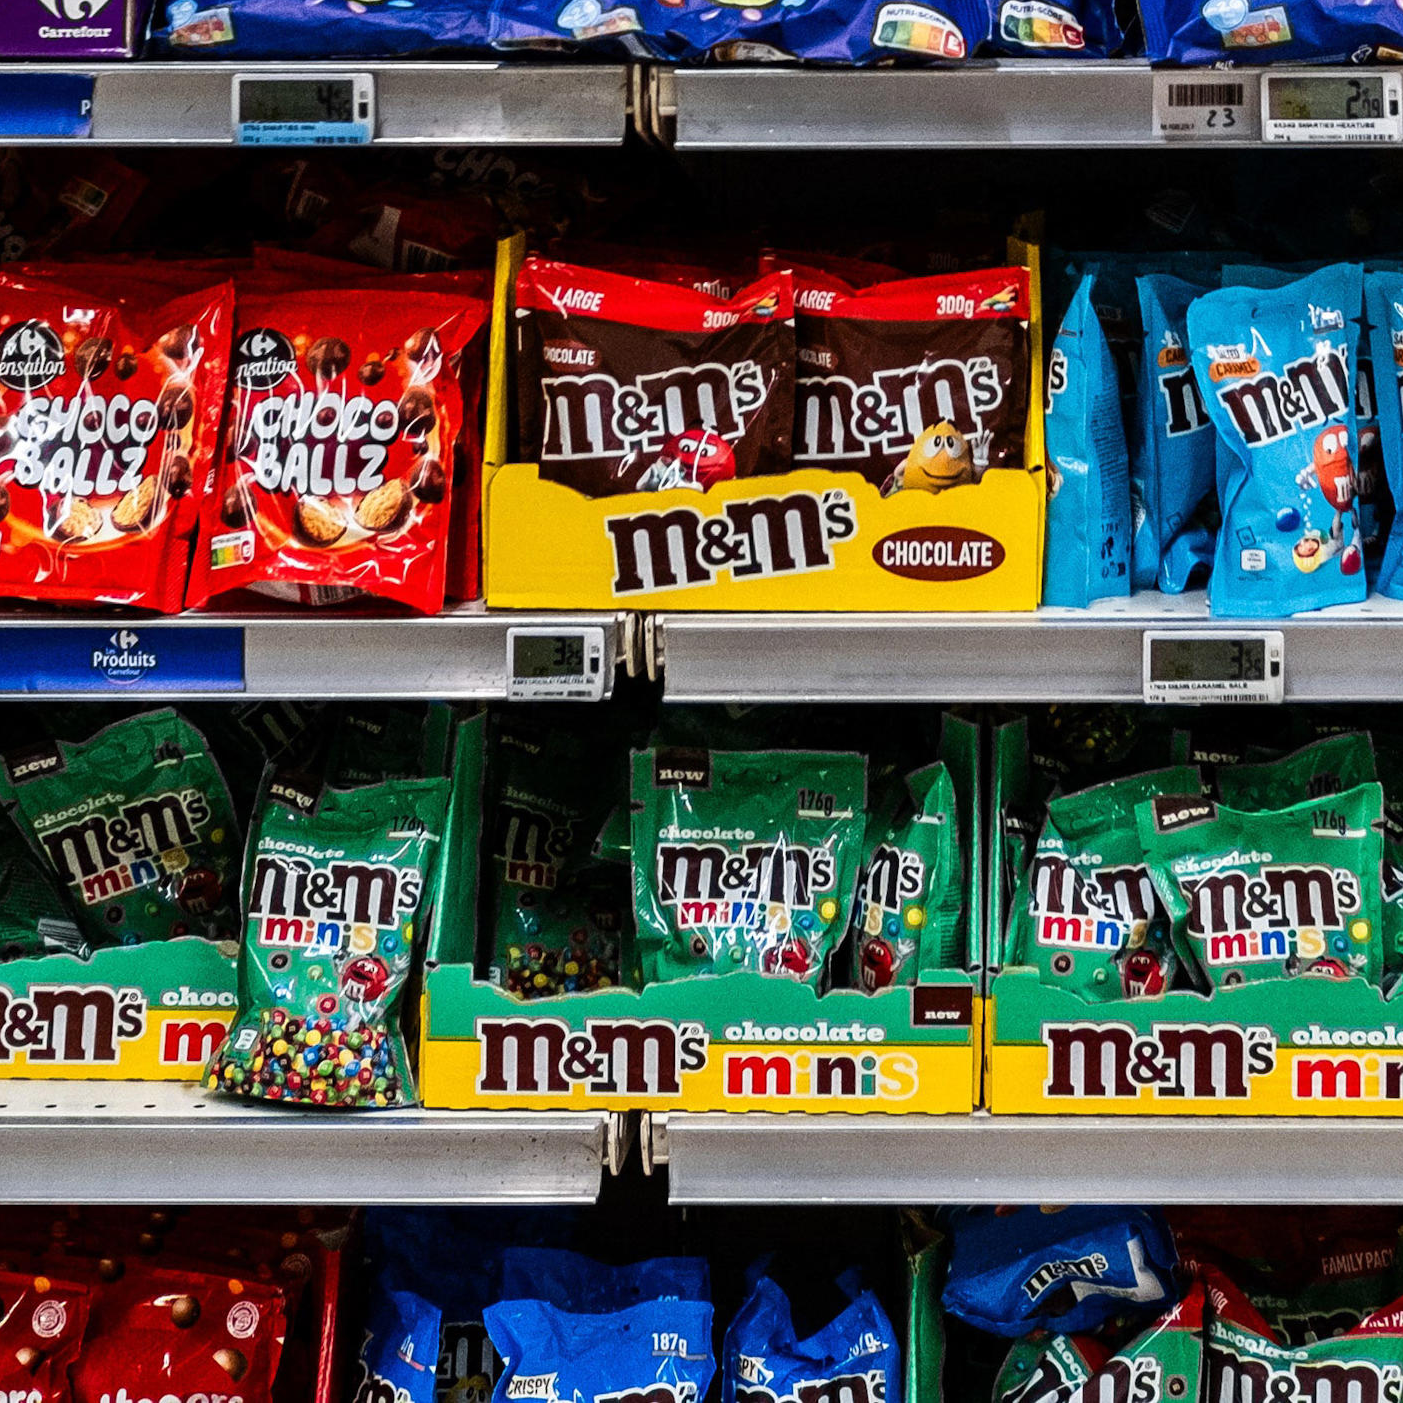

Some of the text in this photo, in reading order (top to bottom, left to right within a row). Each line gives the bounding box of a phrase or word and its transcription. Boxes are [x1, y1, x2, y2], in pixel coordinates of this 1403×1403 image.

[38, 25, 112, 39] Carrefour
[552, 285, 606, 313] LARGE
[936, 294, 975, 319] 300g
[255, 444, 388, 496] BALLZ
[606, 490, 857, 598] m&m's
[881, 540, 993, 568] CHOCOLATE
[13, 754, 58, 778] new
[270, 782, 313, 810] new
[34, 792, 125, 829] chocolate
[1161, 803, 1211, 827] new
[1310, 809, 1347, 835] 176g
[658, 825, 756, 842] chocolate
[1174, 850, 1273, 874] chocolate
[264, 917, 377, 952] minis
[1209, 926, 1326, 965] minis
[924, 1009, 961, 1020] new
[725, 1023, 886, 1043] chocolate
[477, 1019, 709, 1095] m&m's
[1043, 1023, 1277, 1099] m&m's
[726, 1051, 920, 1098] minis
[651, 1332, 688, 1358] 187g
[507, 1376, 552, 1397] CRISPY
